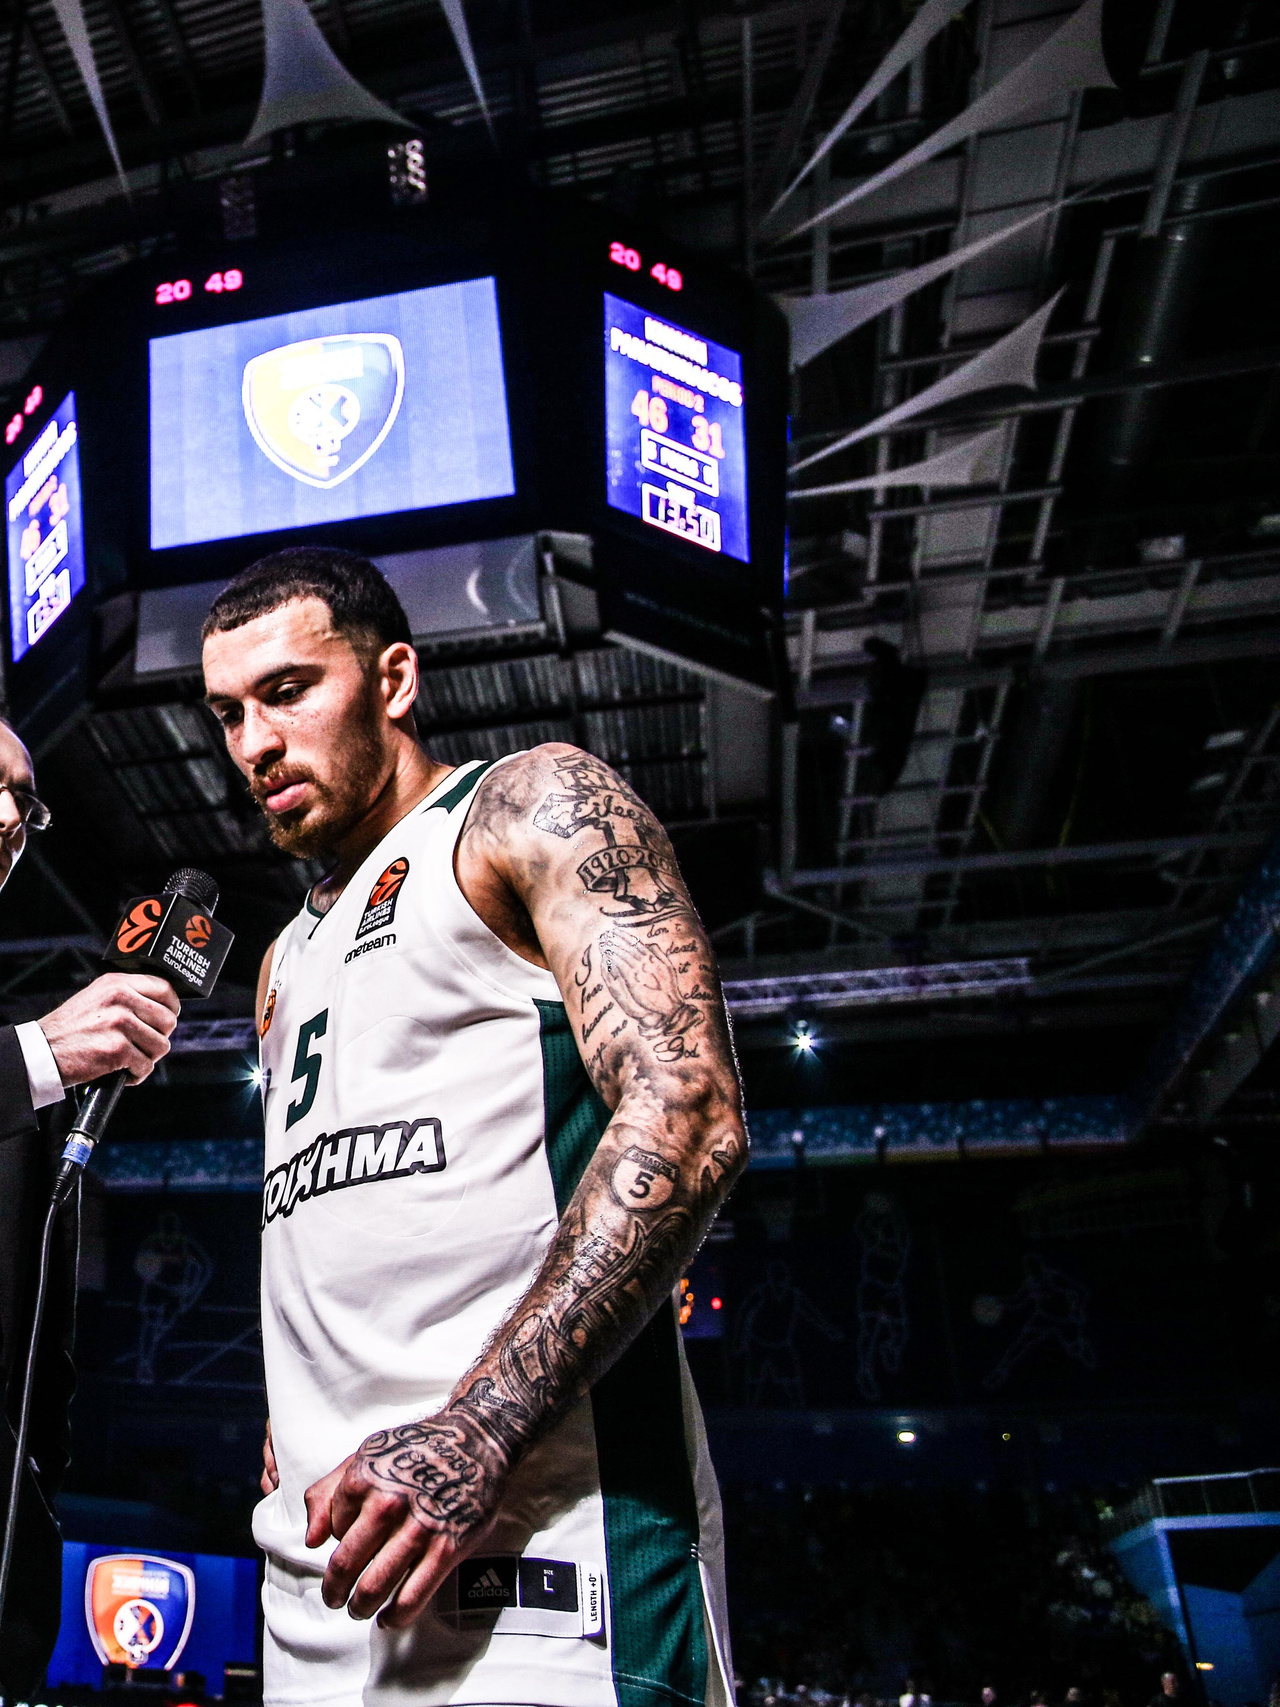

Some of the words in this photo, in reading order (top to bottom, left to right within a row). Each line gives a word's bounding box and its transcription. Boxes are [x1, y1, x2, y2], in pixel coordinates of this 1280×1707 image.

[609, 242, 641, 272] 20
[155, 279, 192, 305] 20
[204, 268, 243, 293] 49
[631, 389, 669, 433] 46
[691, 414, 725, 459] 31
[166, 944, 207, 978] AIRLINES
[172, 935, 211, 969] TURKISH
[344, 933, 396, 964] oneteam
[163, 953, 203, 987] EuroLeague
[285, 1007, 329, 1133] 5
[628, 1171, 655, 1199] 5
[468, 1586, 510, 1599] adidas
[543, 1575, 555, 1593] L
